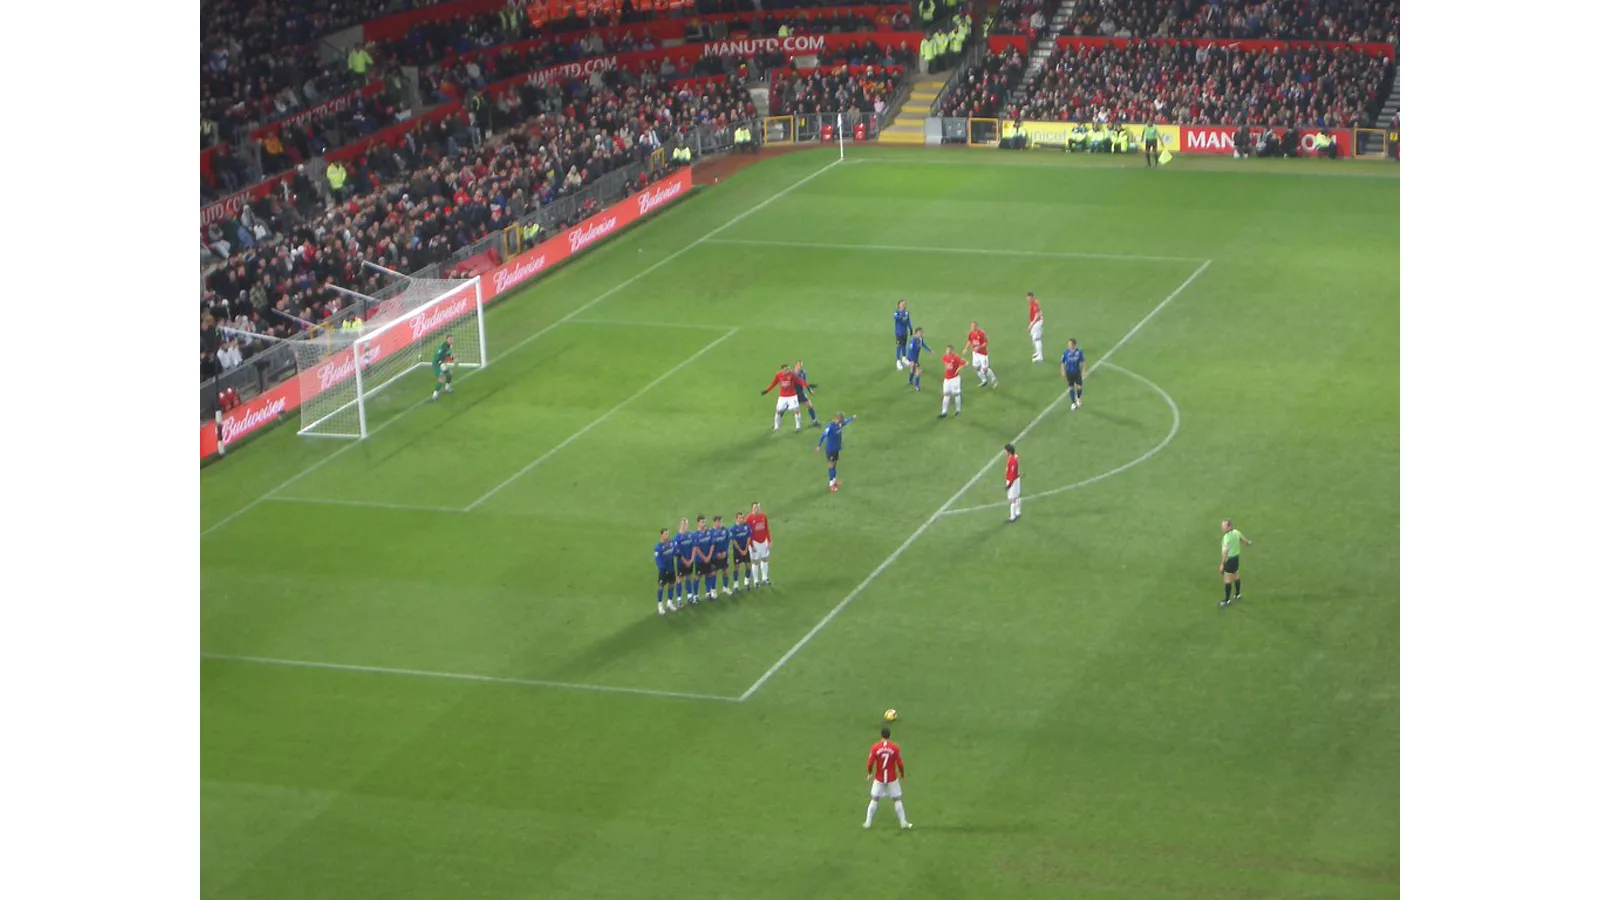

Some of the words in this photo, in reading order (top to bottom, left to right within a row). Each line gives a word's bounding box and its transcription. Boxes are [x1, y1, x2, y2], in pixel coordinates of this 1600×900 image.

[704, 35, 824, 57] MANUTD.COM
[638, 178, 681, 215] Budweiser
[568, 216, 616, 252] Budweiser
[493, 254, 546, 294] Budweiser
[409, 298, 467, 341] Budweiser
[221, 396, 286, 443] Budweiser
[881, 752, 890, 769] 7
